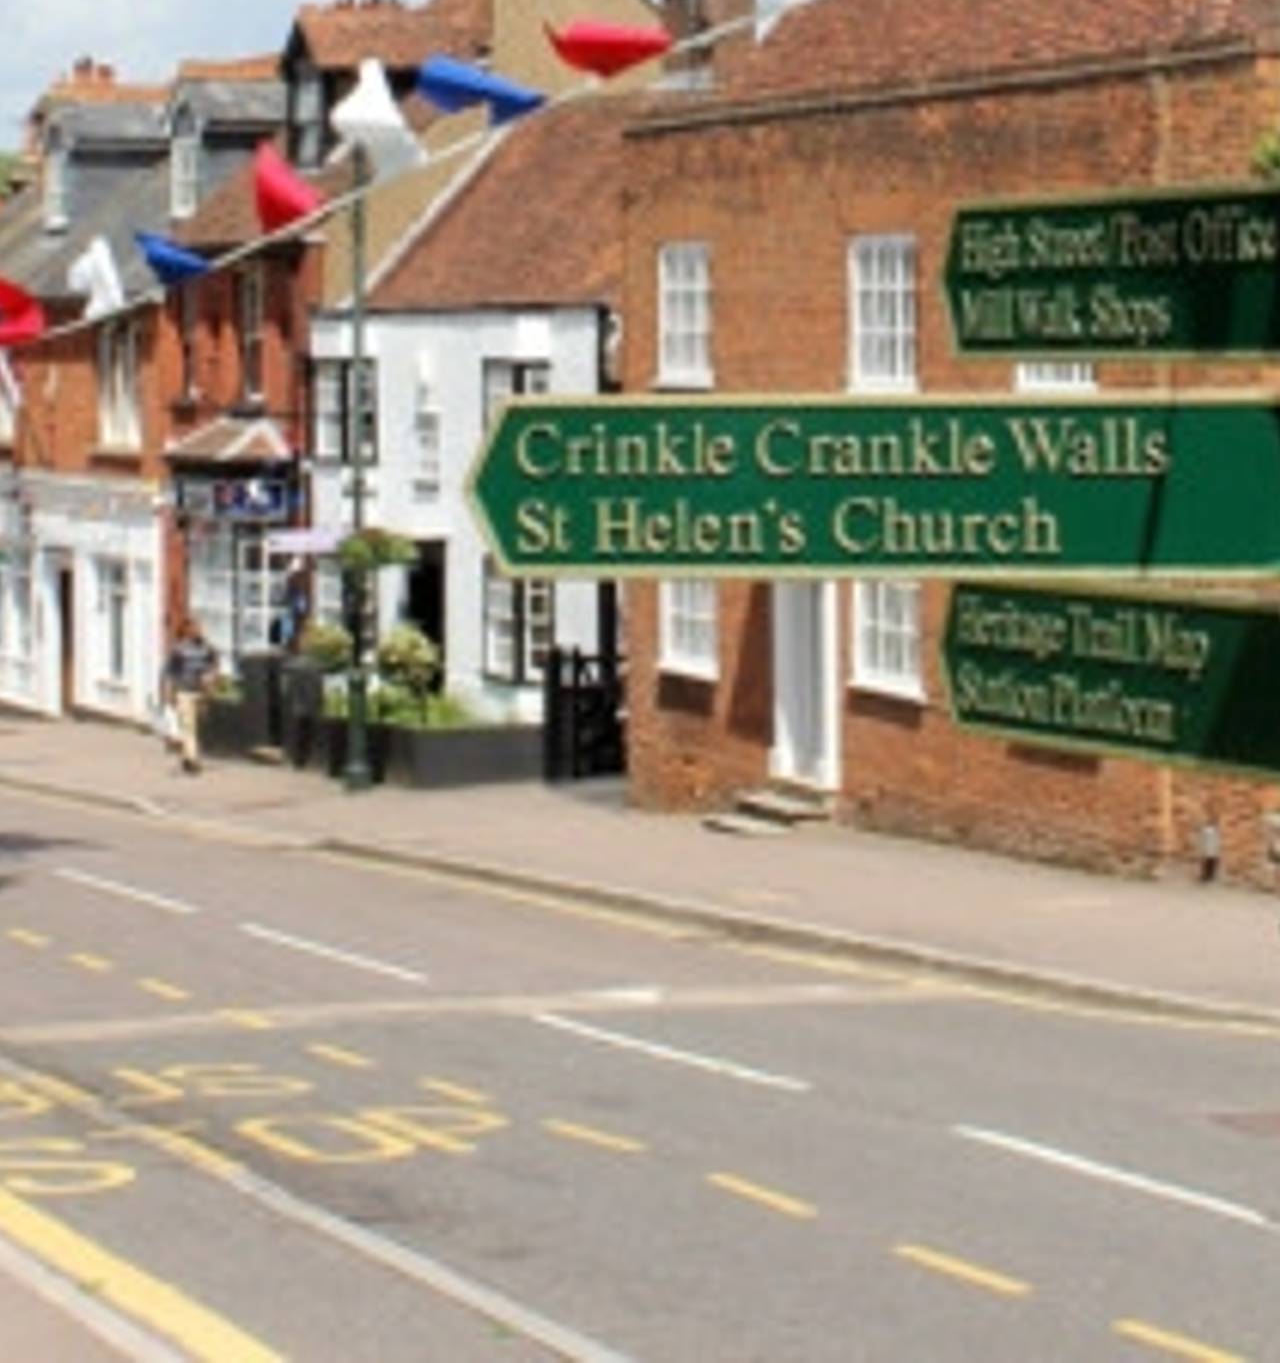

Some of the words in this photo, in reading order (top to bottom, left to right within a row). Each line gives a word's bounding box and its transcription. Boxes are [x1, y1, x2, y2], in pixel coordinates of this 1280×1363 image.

[1182, 205, 1278, 263] Office
[516, 422, 735, 476] Crinkle
[755, 420, 997, 476] Crankle
[1007, 418, 1171, 476] Walls
[516, 500, 570, 554] St
[596, 498, 807, 555] Helen's
[830, 497, 1061, 555] Church
